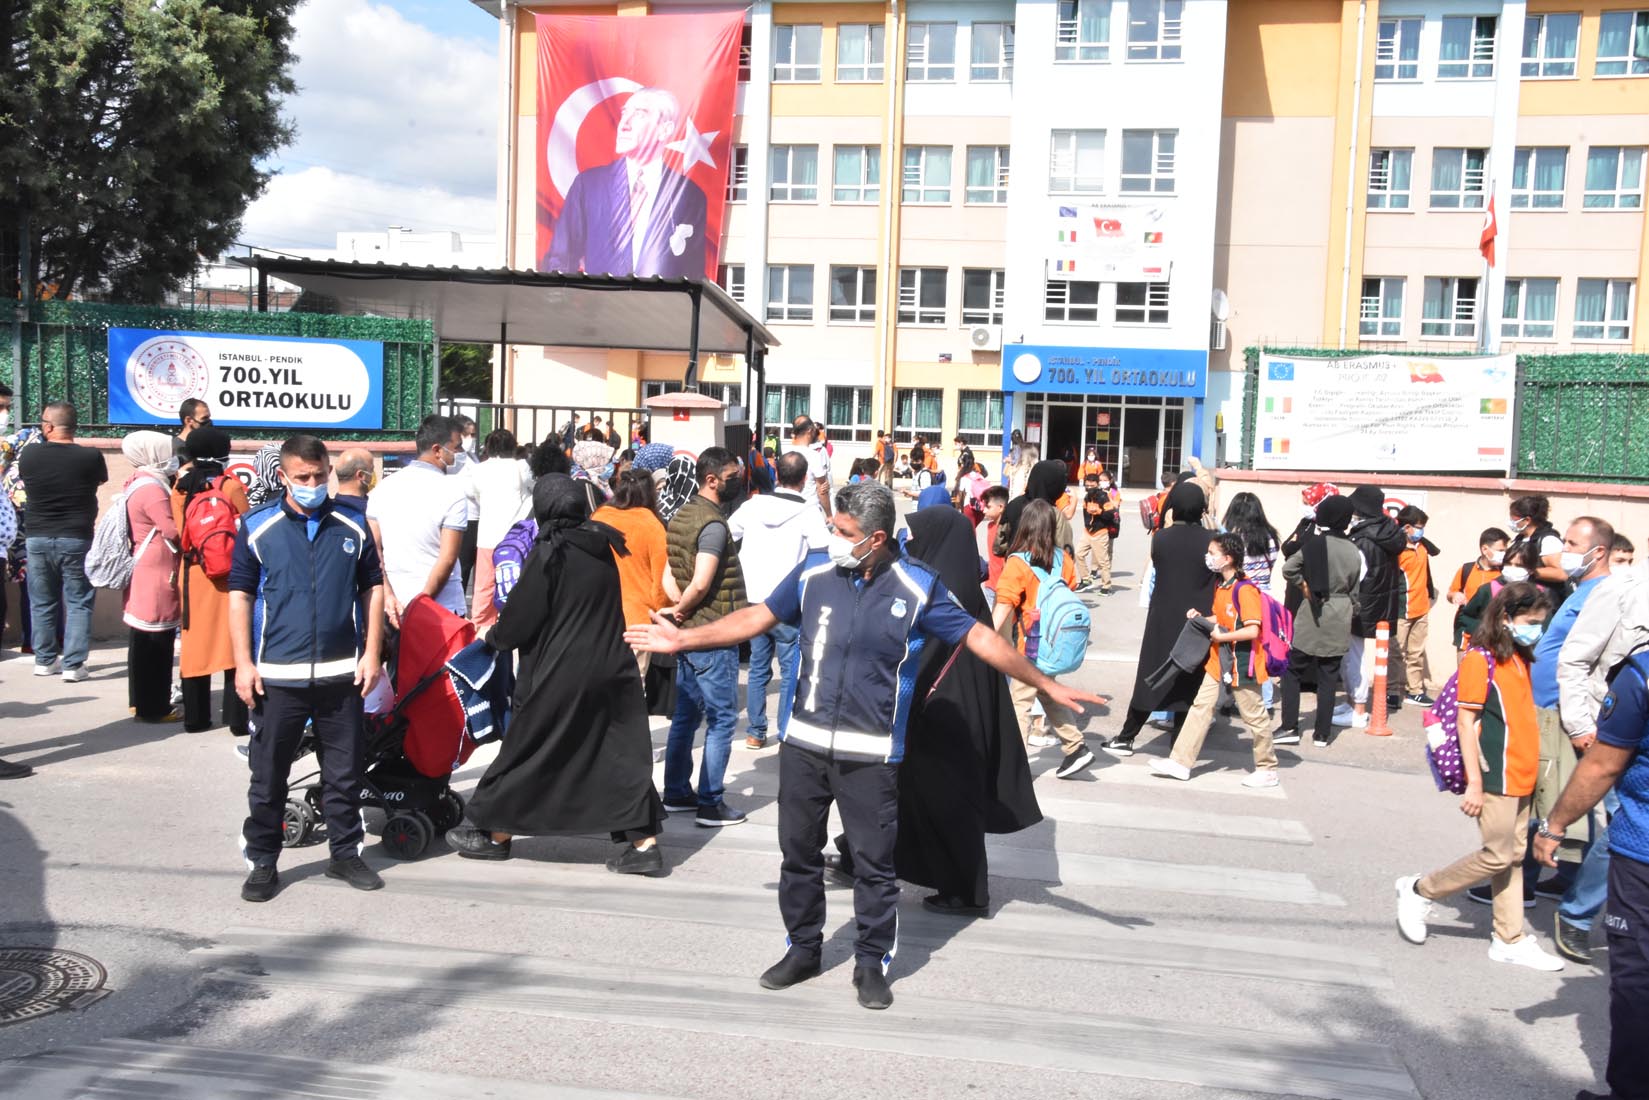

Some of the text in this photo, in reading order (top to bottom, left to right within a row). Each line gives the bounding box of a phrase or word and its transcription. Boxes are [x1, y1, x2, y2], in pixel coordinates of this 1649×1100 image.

[219, 352, 262, 362] İSTANBUL
[270, 355, 303, 364] PENDİK
[1327, 360, 1340, 369] AB
[219, 366, 303, 386] 700.YIL
[1048, 368, 1196, 388] 700. YIL ORTAOKULU
[219, 390, 351, 410] ORTAOKULU
